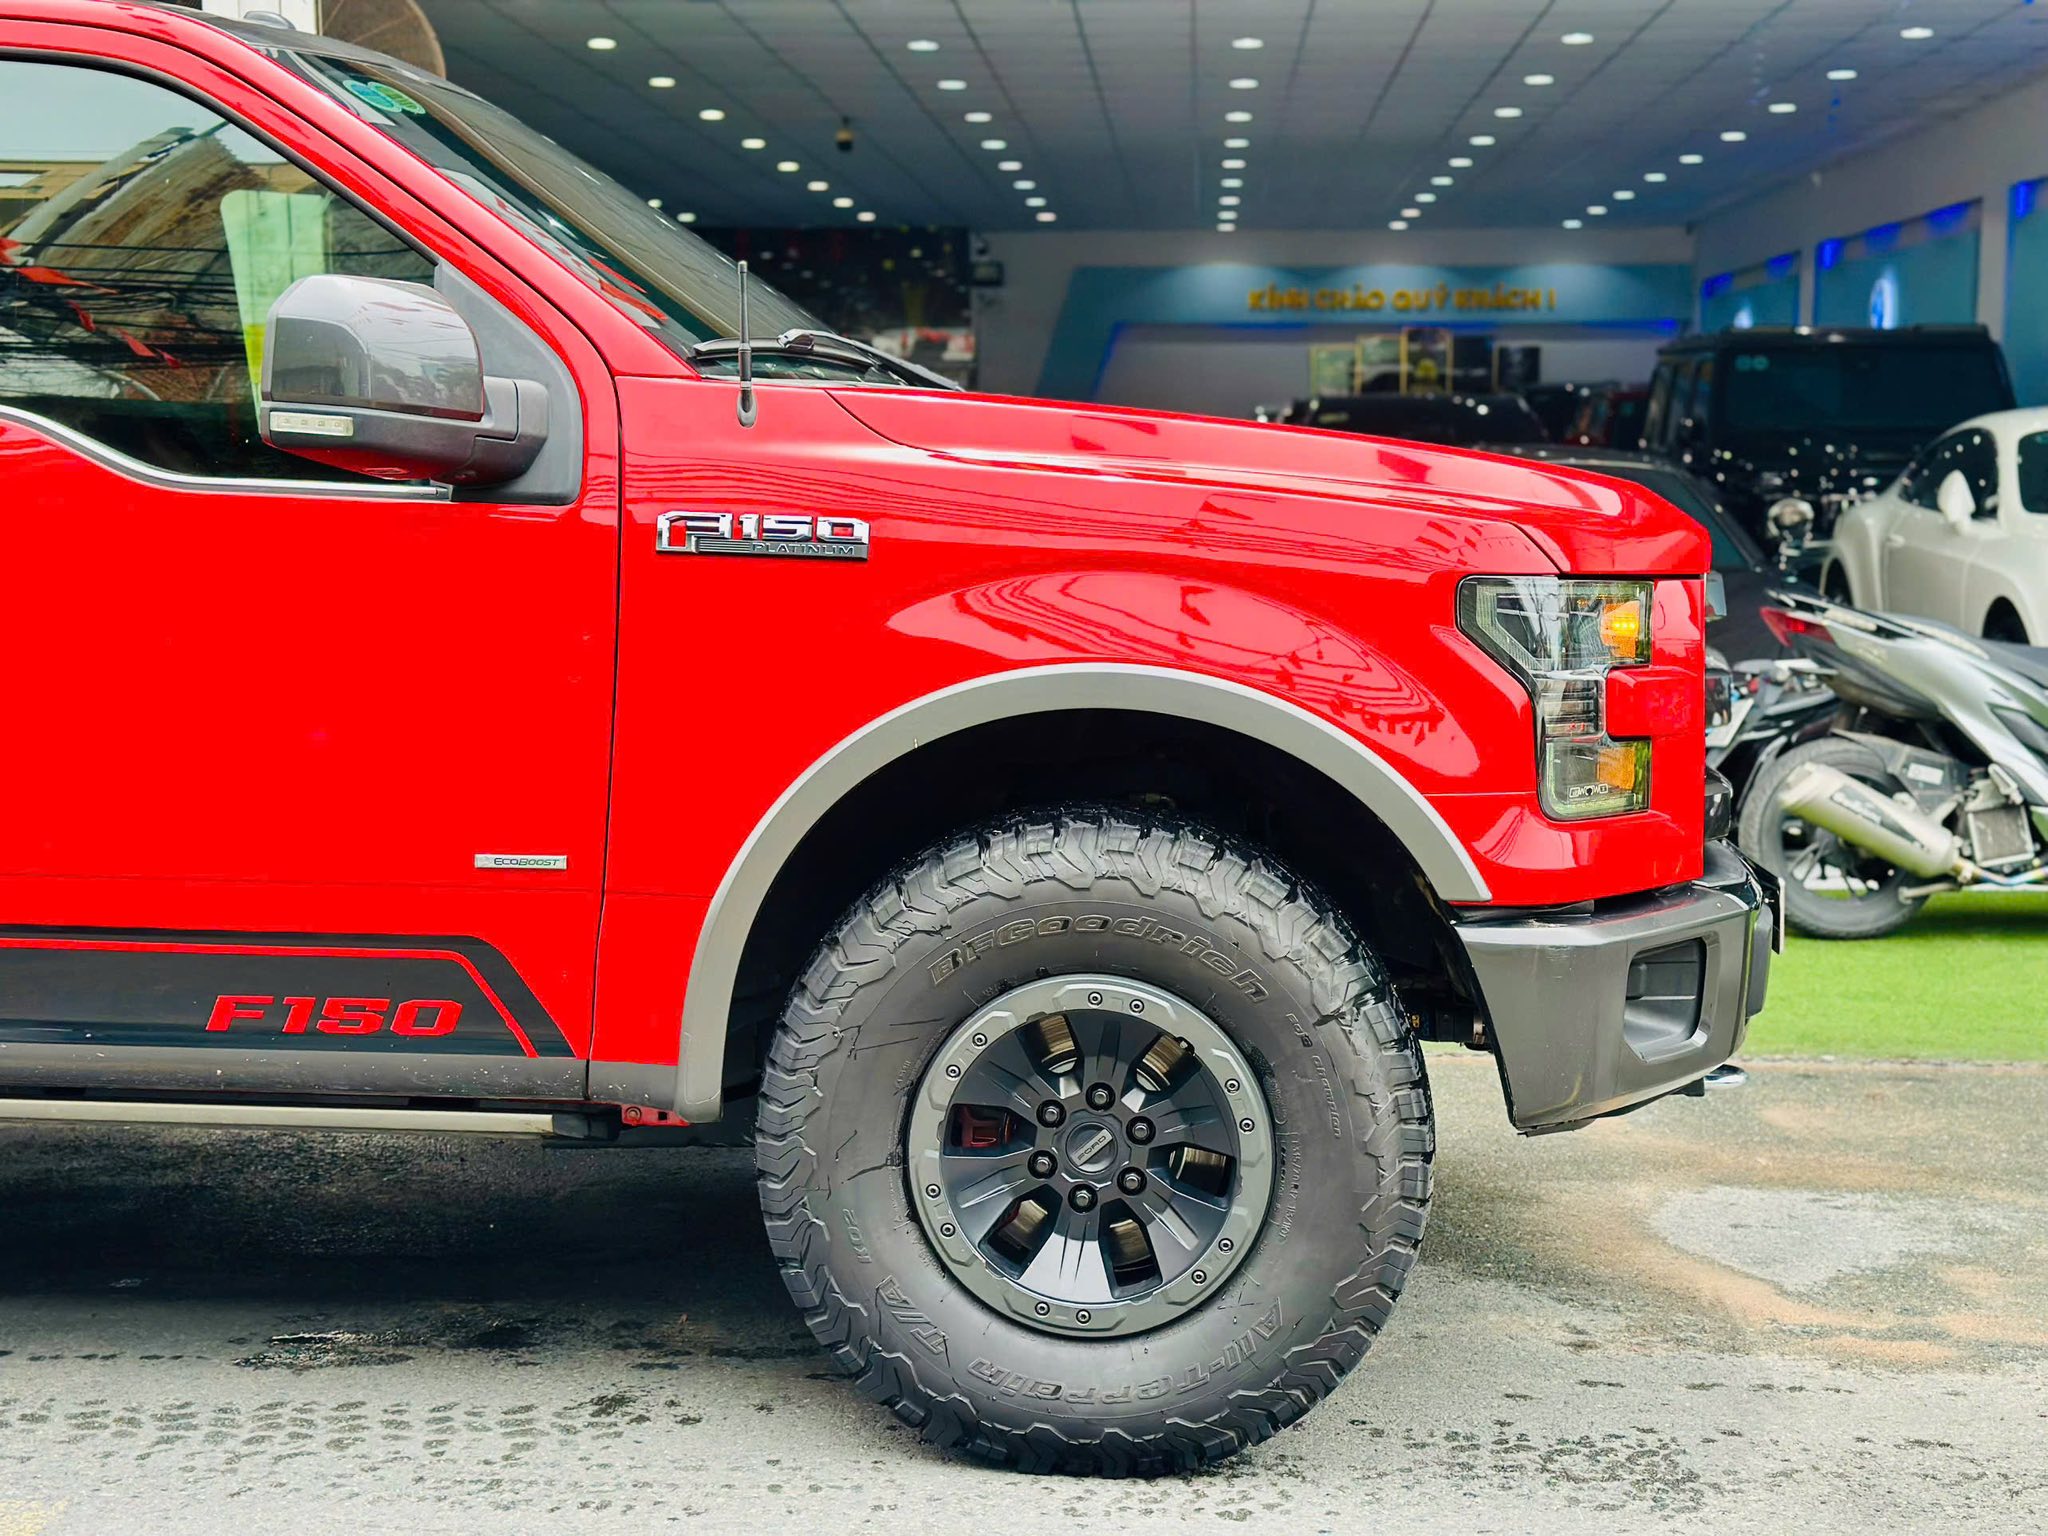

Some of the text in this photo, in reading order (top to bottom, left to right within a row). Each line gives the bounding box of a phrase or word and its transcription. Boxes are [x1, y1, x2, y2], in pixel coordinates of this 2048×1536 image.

[752, 542, 855, 556] PLATINUM
[927, 914, 1270, 1003] BFGoodrich
[205, 995, 463, 1036] F150
[1077, 1135, 1107, 1161] FORD
[842, 1207, 872, 1264] KO2
[875, 1274, 1284, 1405] All-Terrain T/A
